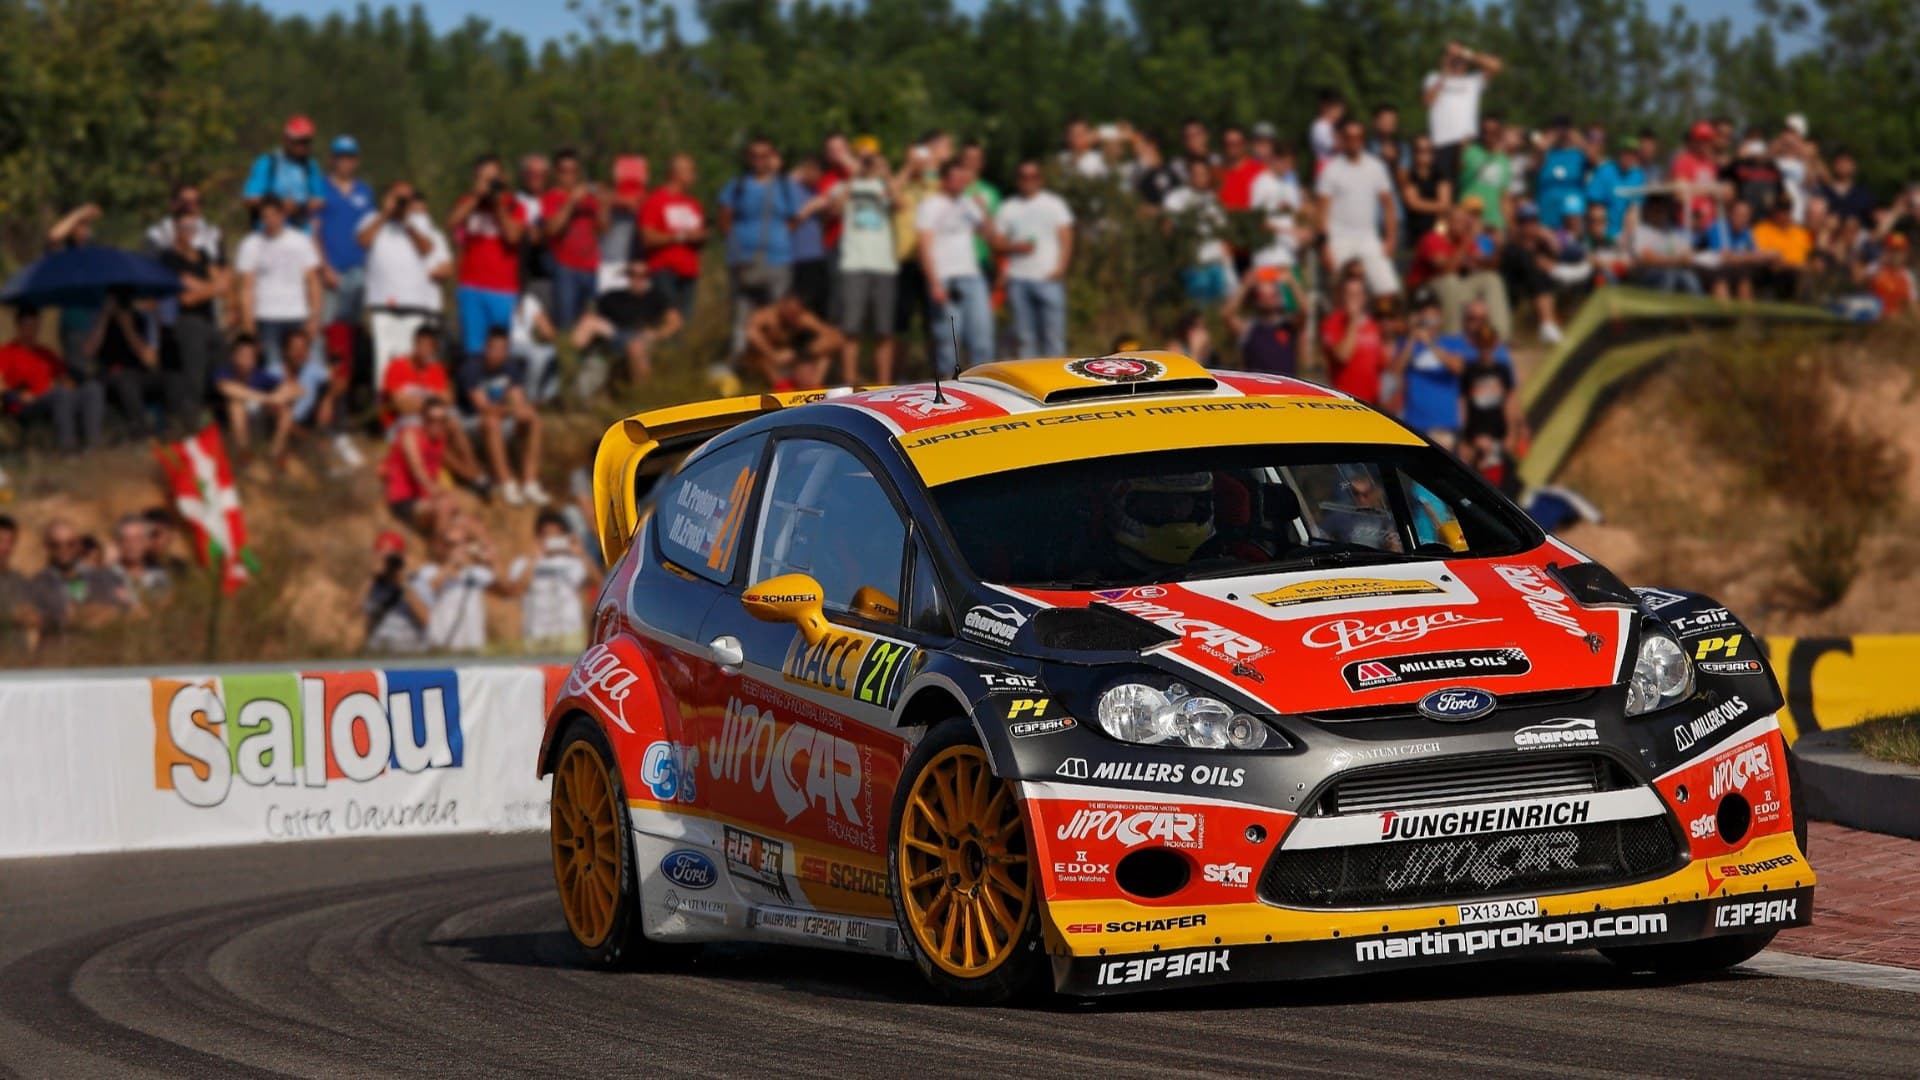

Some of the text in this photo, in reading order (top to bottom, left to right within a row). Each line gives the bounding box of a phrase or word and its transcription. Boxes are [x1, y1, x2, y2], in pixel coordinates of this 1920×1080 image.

[906, 420, 1031, 450] JIPOCAR
[1036, 409, 1136, 426] CZECH
[1144, 401, 1286, 416] NATIONAL
[706, 465, 758, 573] 21
[1301, 609, 1504, 655] Praga
[1695, 634, 1743, 660] P1
[859, 642, 904, 705] 21
[1399, 655, 1508, 678] MILLERS OILS
[1007, 698, 1050, 719] P1
[1437, 692, 1480, 712] Ford
[1690, 695, 1749, 741] MILLERS OILS
[168, 676, 454, 808] Salou
[1355, 741, 1441, 759] SATUM CZECH
[1514, 728, 1599, 746] charouz
[1092, 762, 1246, 787] MILLERS OILS
[1379, 800, 1590, 841] JUNGHEINRICH
[673, 855, 709, 885] Ford
[1054, 862, 1110, 874] EDOX
[1460, 897, 1537, 922] PX13 ACJ
[1355, 913, 1668, 963] martinprokop.com
